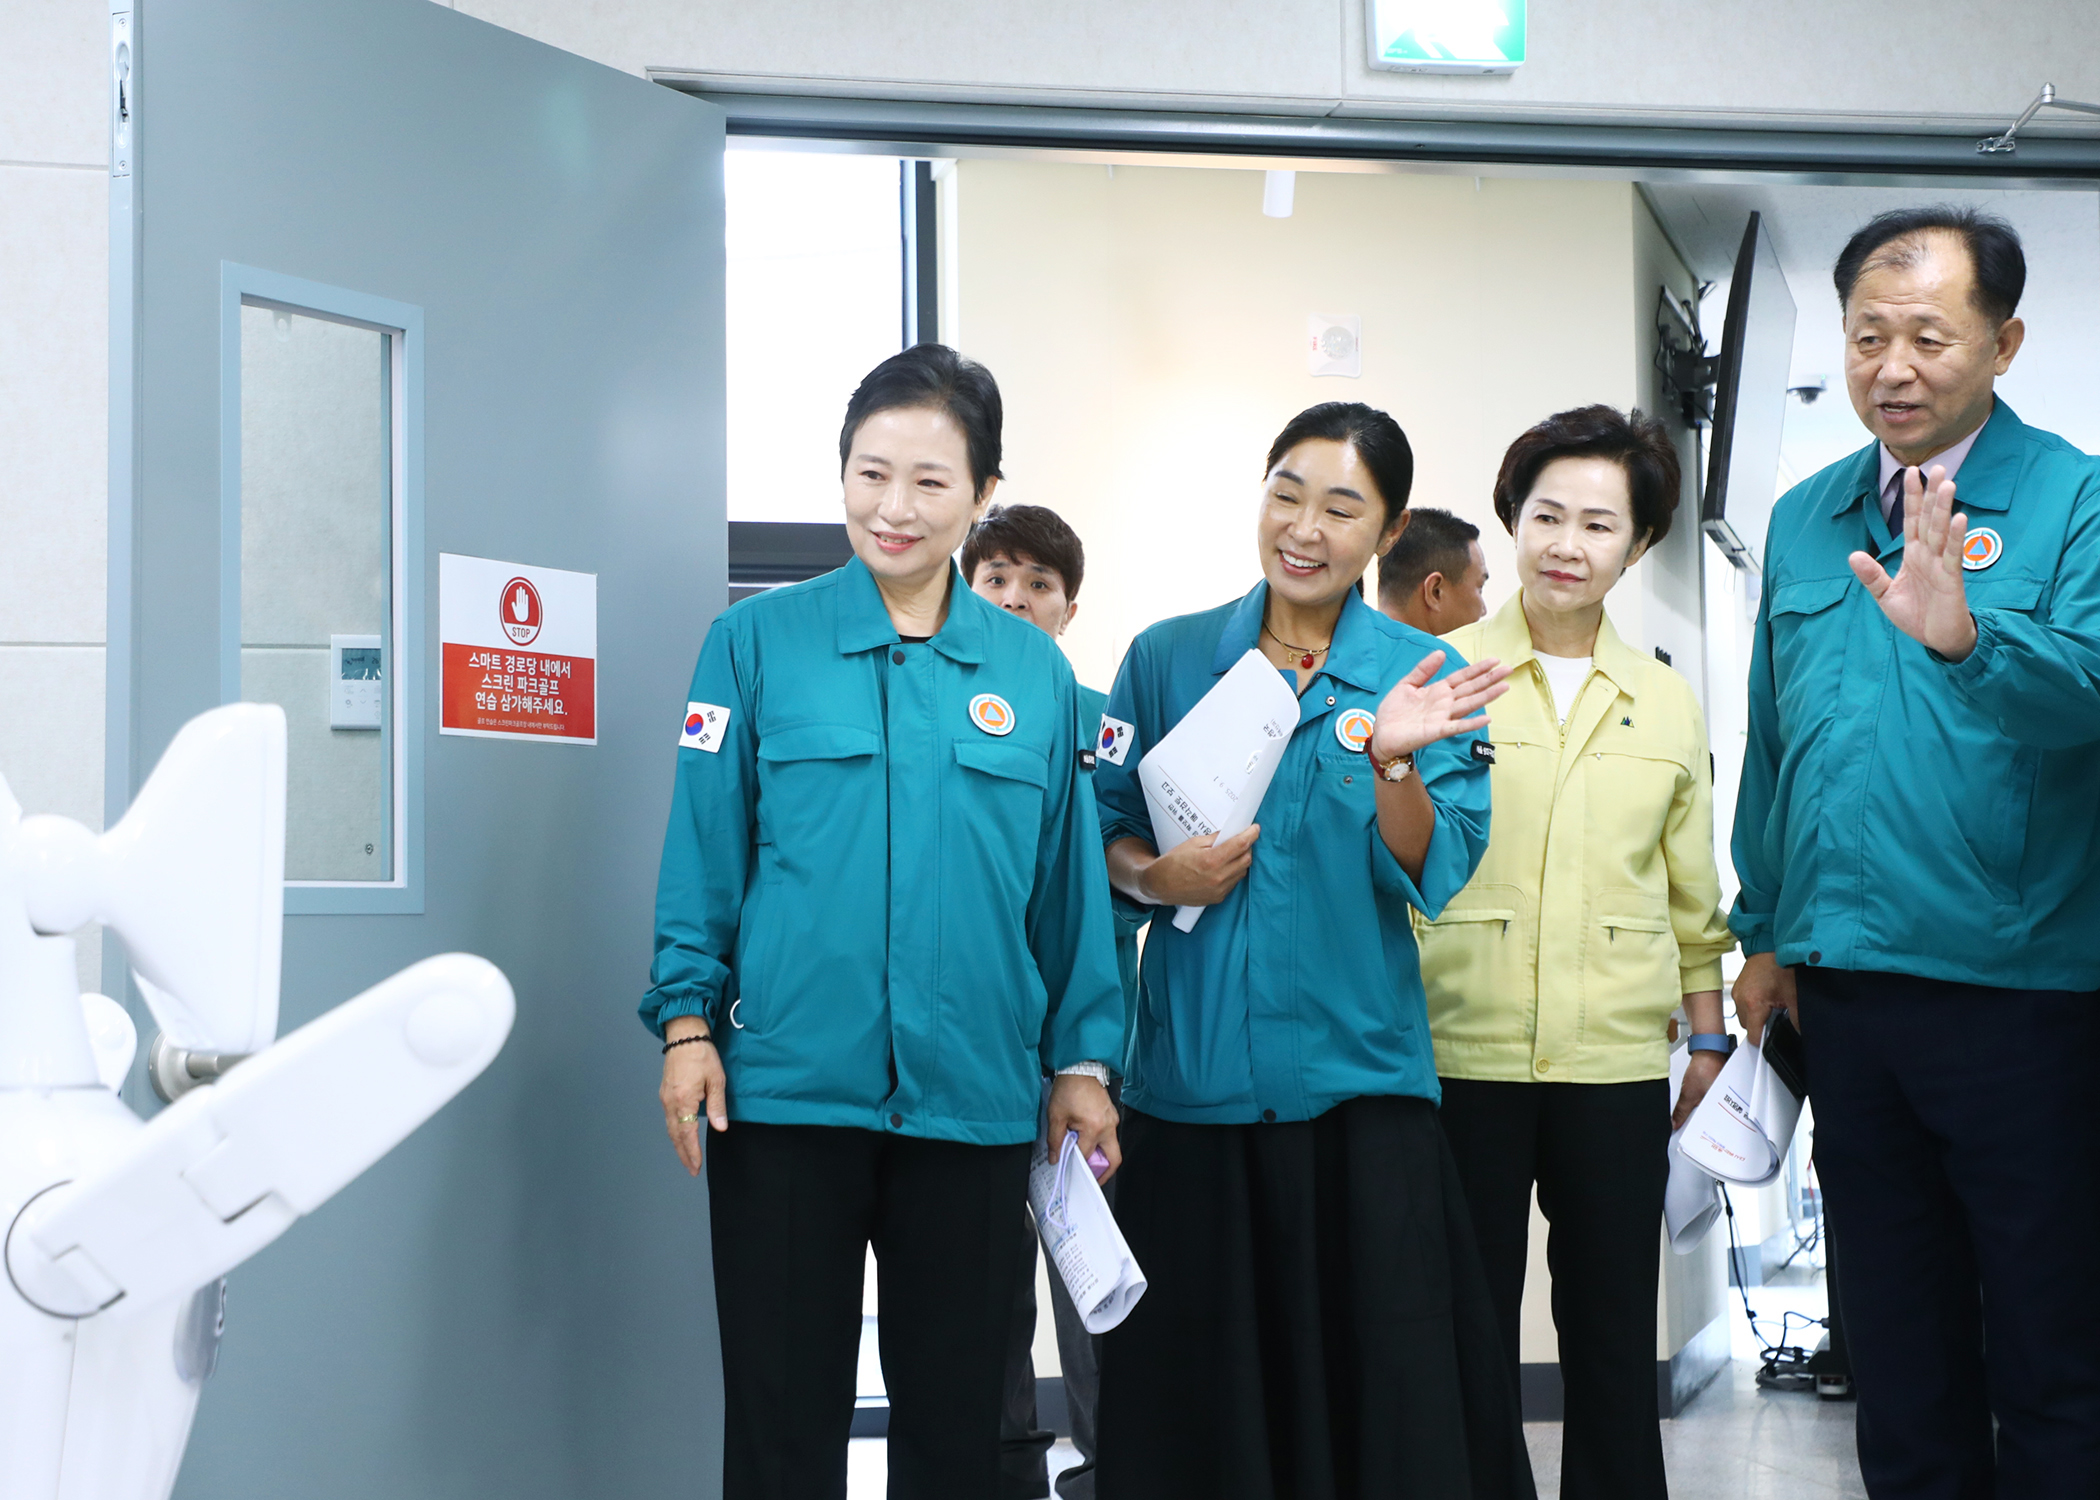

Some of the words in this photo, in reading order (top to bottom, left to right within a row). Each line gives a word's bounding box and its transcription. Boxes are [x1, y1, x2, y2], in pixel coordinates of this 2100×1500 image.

[512, 626, 531, 638] STOP
[468, 652, 502, 671] 스마트
[505, 655, 537, 676] 경로당
[540, 659, 571, 679] 내에서
[481, 673, 514, 693] 스크린
[517, 676, 560, 696] 파크골프
[475, 691, 497, 711] 연습
[500, 694, 568, 715] 삼가해주세요.
[1161, 781, 1176, 797] 보고
